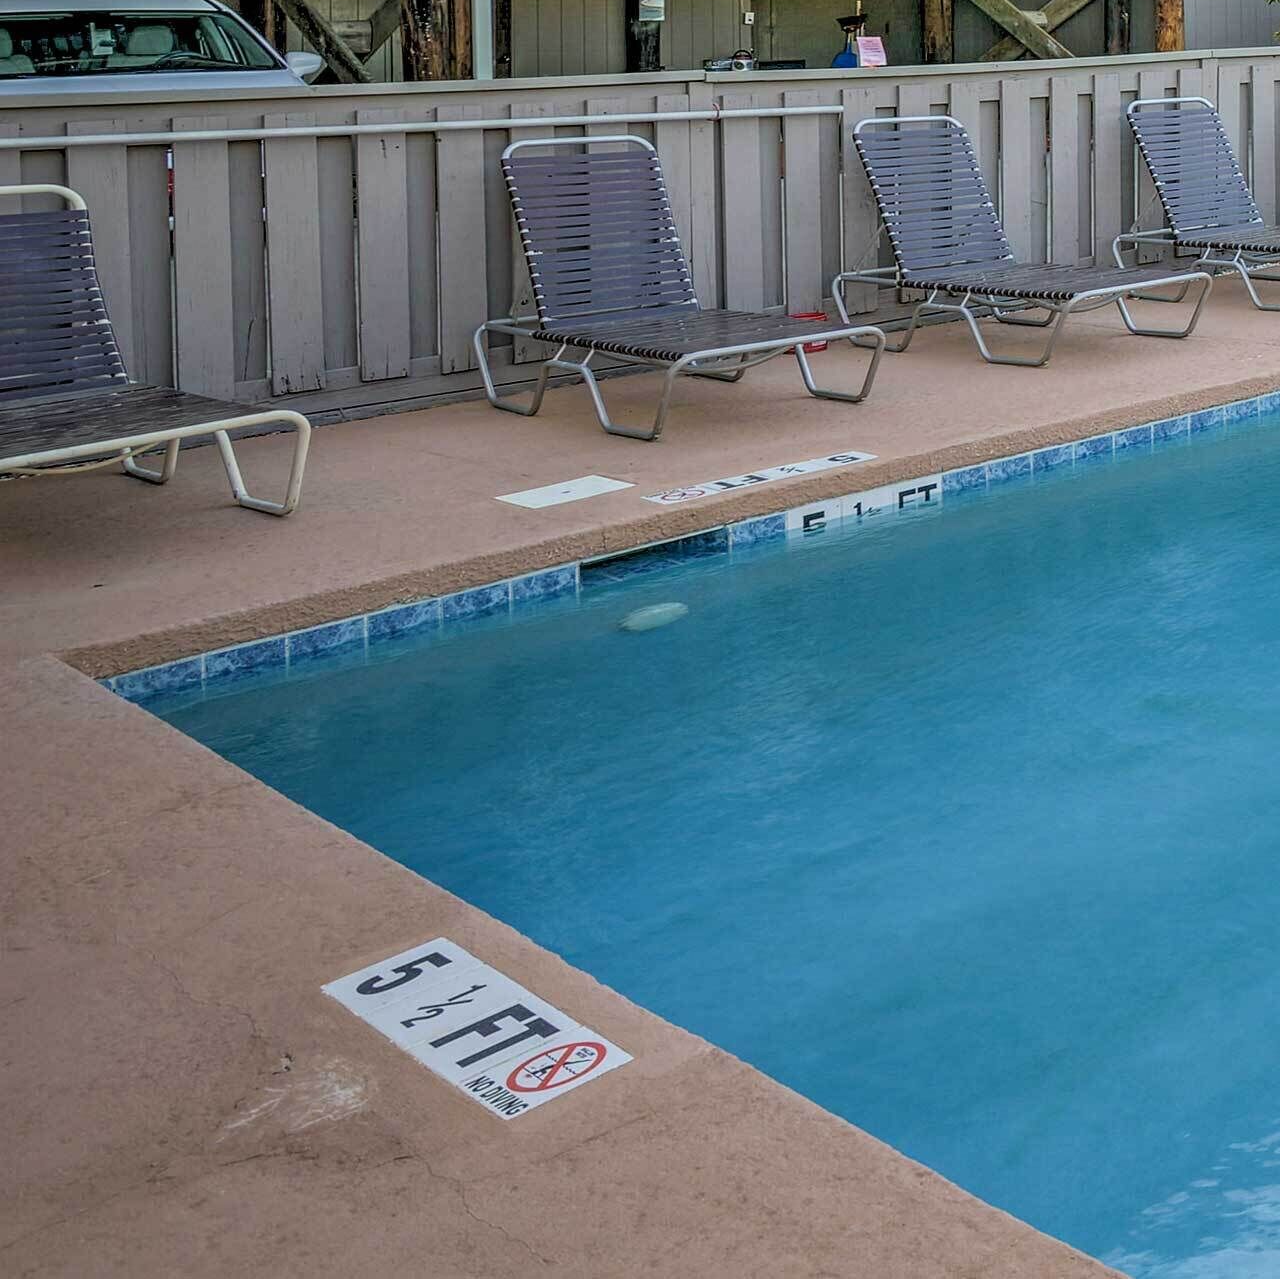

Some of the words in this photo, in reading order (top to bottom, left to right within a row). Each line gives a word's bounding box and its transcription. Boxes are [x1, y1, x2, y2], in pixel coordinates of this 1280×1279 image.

[714, 474, 769, 490] FT
[898, 483, 938, 509] FT
[356, 952, 453, 996] 5
[430, 1003, 561, 1068] FT
[464, 1075, 496, 1093] NO
[480, 1085, 529, 1116] DIVING
